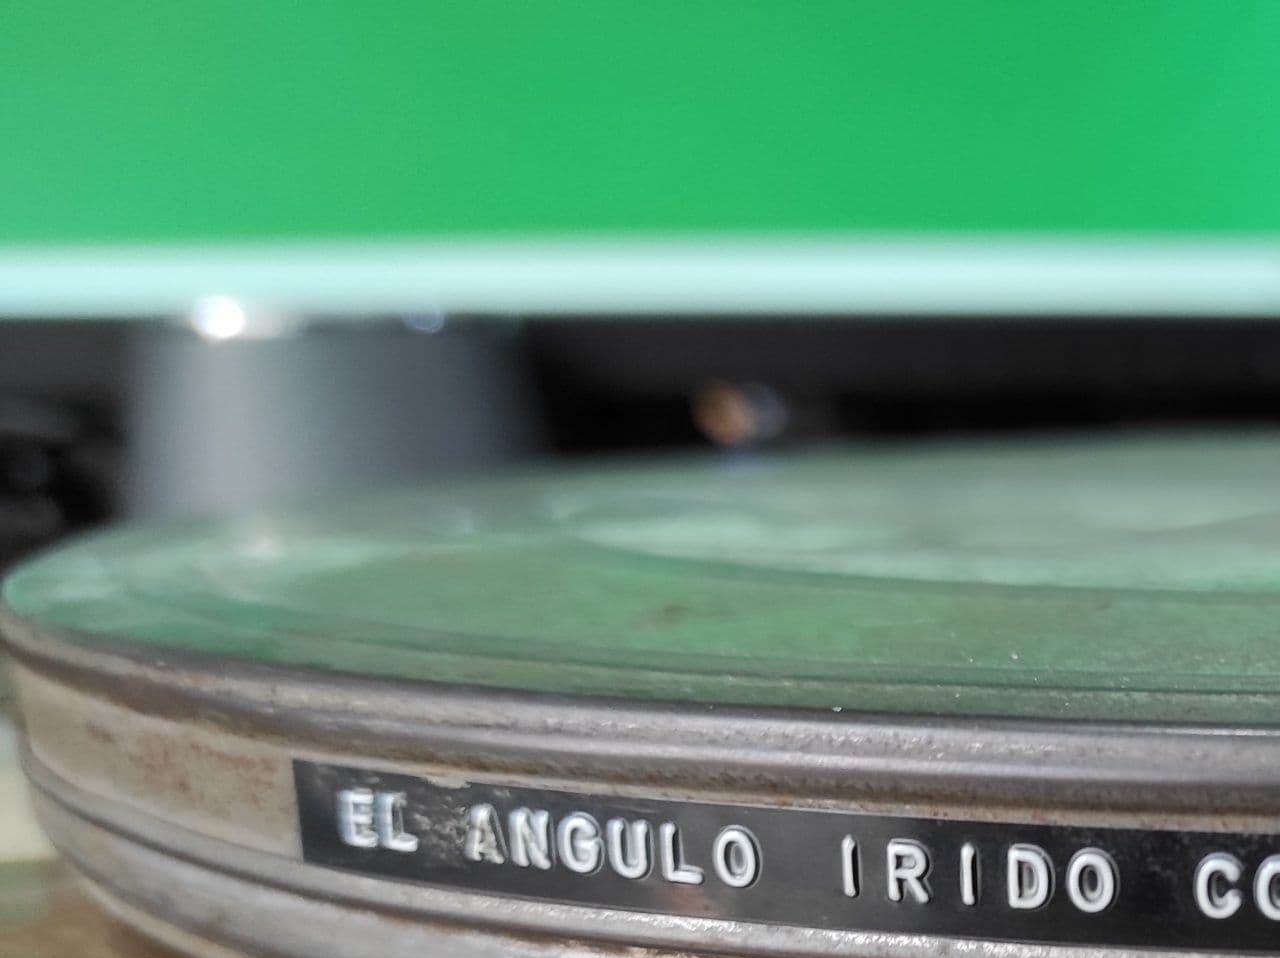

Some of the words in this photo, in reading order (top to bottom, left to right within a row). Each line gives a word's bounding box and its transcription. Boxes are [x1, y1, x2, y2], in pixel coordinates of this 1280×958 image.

[336, 788, 418, 853] EL
[462, 802, 761, 888] ANGULO
[841, 834, 1119, 914] IRIDO
